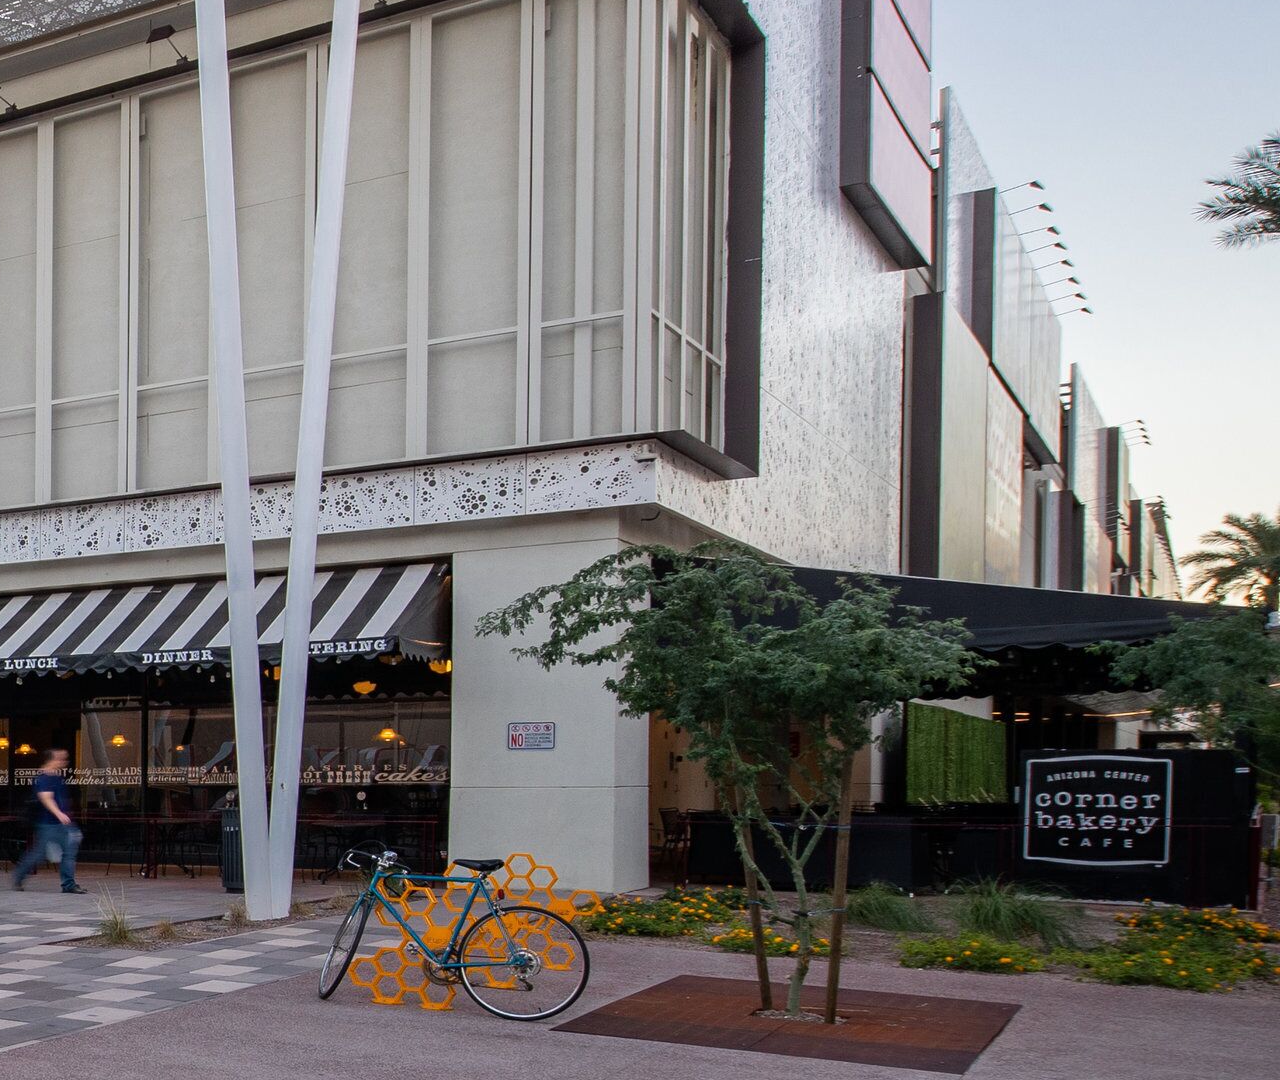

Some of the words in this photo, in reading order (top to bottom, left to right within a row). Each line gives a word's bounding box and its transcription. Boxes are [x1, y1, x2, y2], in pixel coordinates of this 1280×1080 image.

[4, 656, 59, 672] LUNCH
[142, 649, 214, 665] DINNER
[308, 639, 388, 656] TERING
[511, 733, 523, 748] NO
[14, 769, 42, 777] COMBO
[105, 767, 143, 776] SALADS
[200, 765, 231, 774] SAL
[307, 764, 408, 772] ASTRIES
[374, 765, 450, 783] cakes
[301, 771, 323, 779] OT
[327, 770, 371, 783] FRESH
[1046, 770, 1096, 783] ARIZONA
[1104, 770, 1151, 783] CENTER
[14, 778, 39, 787] LUN
[1035, 791, 1161, 810] corner
[1034, 810, 1160, 835] bakery
[1058, 837, 1134, 849] CAFE
